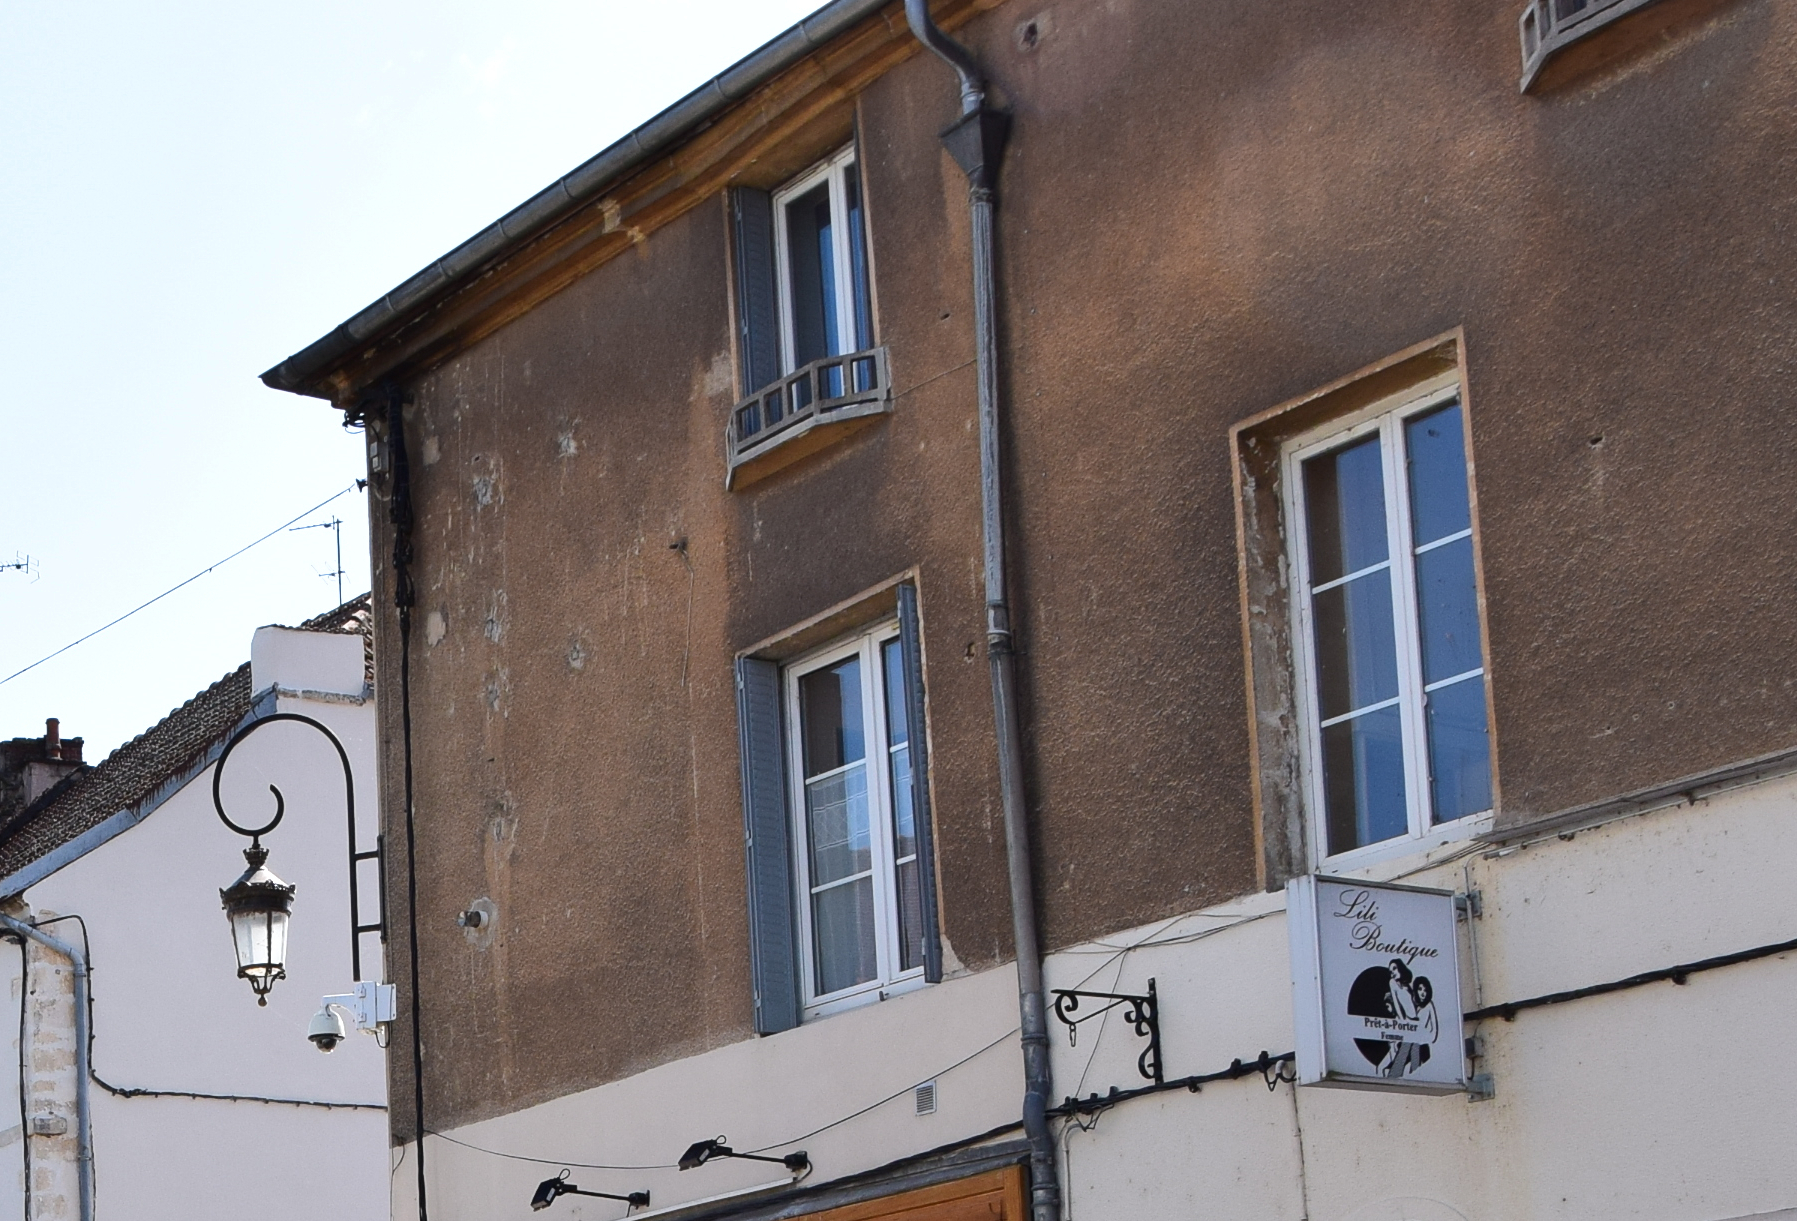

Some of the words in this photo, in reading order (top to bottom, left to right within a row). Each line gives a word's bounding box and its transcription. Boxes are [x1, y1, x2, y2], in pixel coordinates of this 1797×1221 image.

[1333, 889, 1380, 921] Lili
[1349, 920, 1439, 965] Boutique
[1364, 1017, 1419, 1033] Prêt-à-Porter
[1380, 1031, 1405, 1042] Femme
